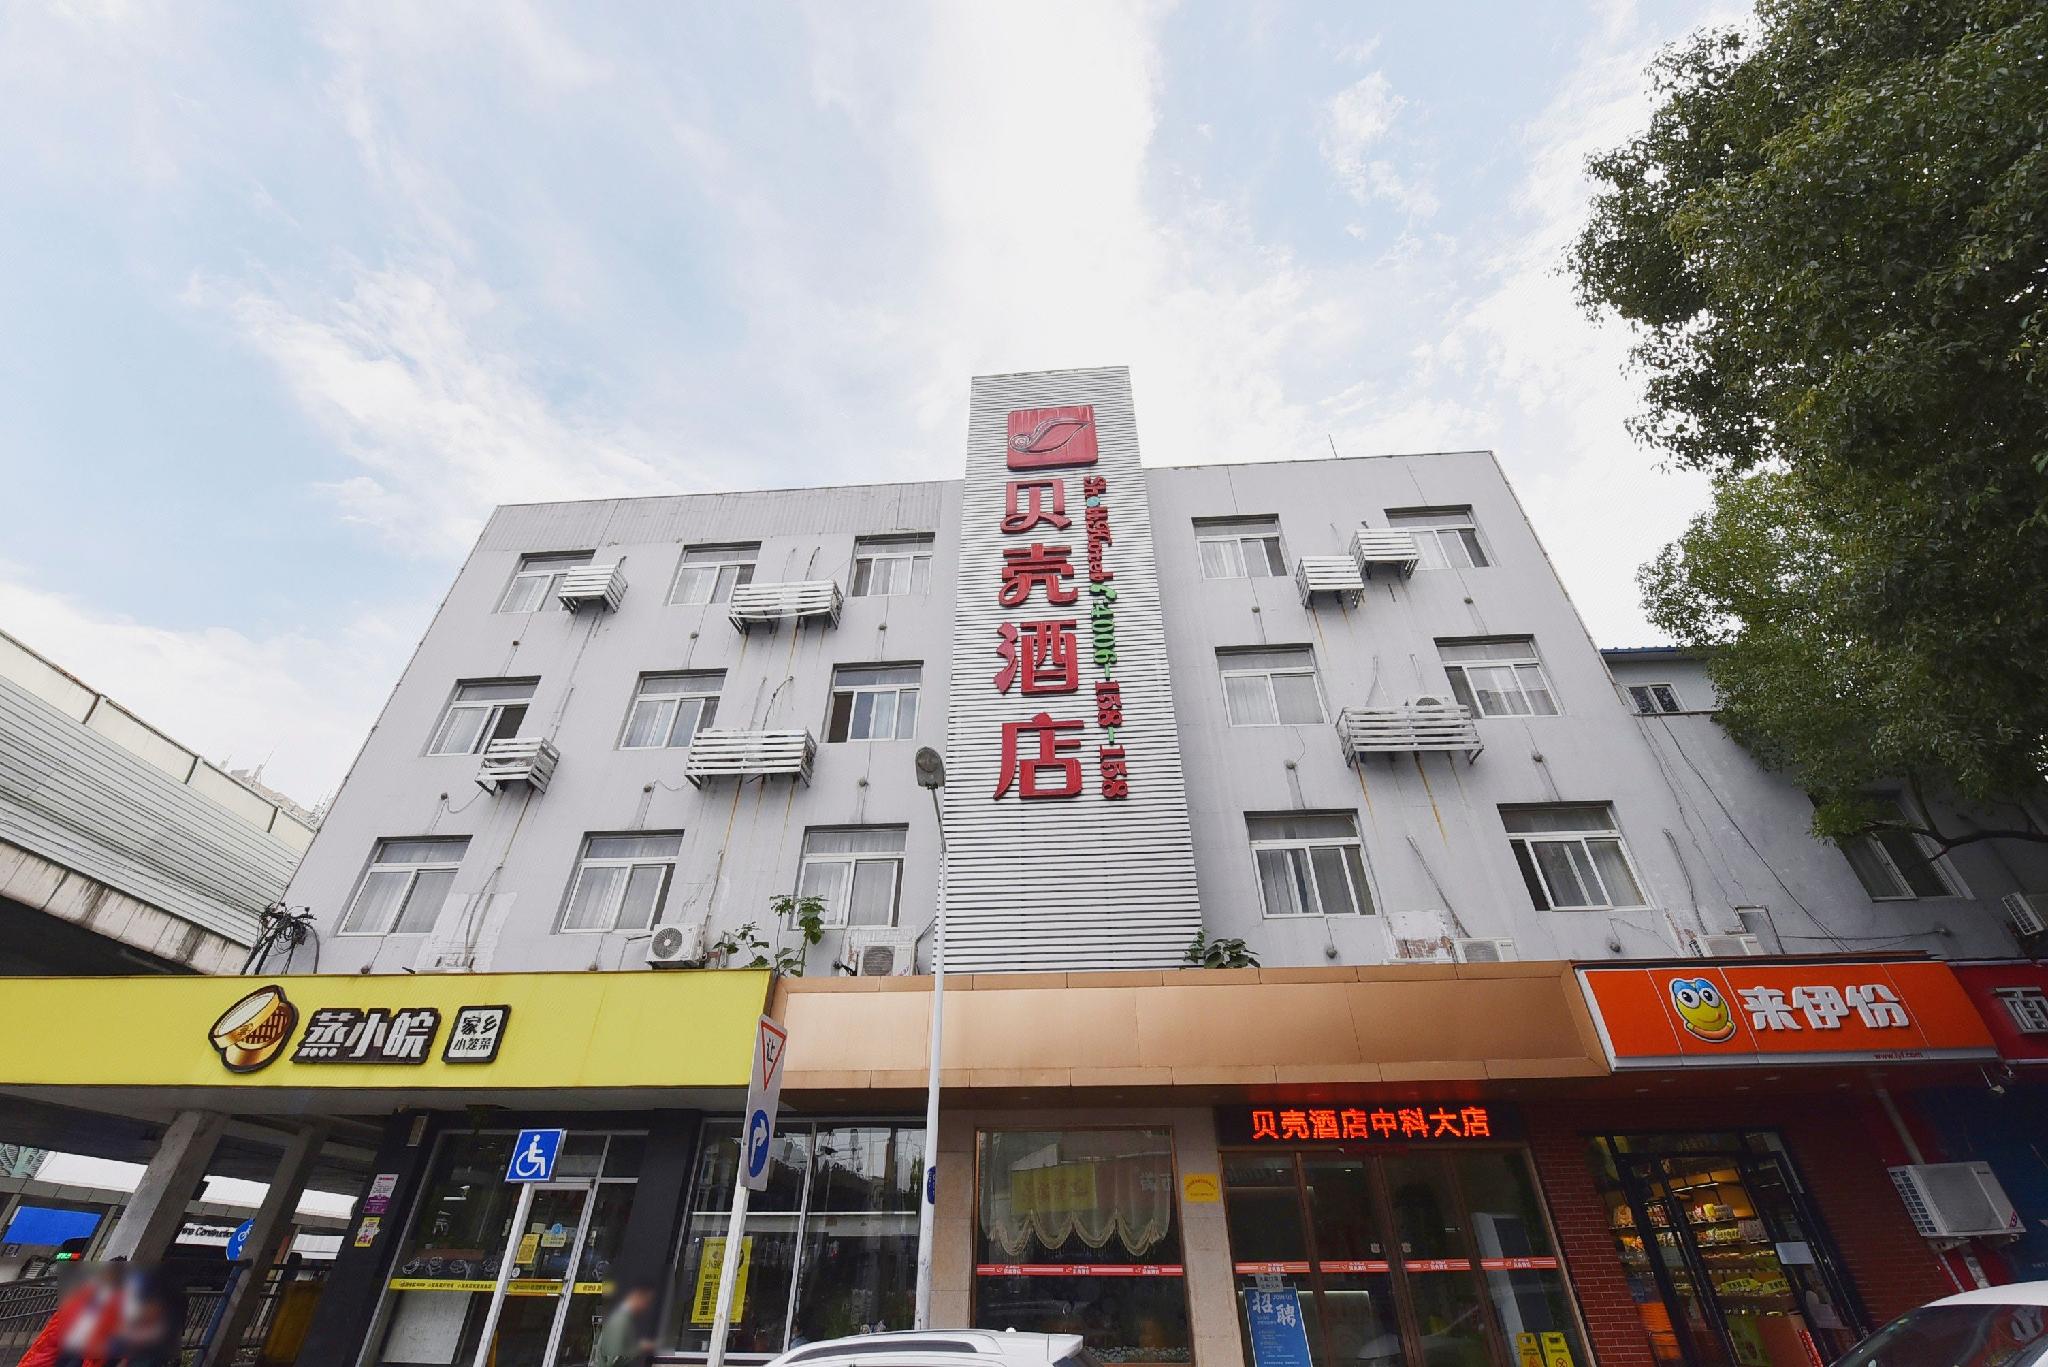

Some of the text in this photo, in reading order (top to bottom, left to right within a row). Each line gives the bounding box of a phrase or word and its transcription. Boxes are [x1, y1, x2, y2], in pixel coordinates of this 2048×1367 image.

[993, 479, 1085, 800] 贝壳酒店
[461, 1016, 497, 1035] 家乡
[1738, 985, 1910, 1030] 来伊份
[299, 1011, 436, 1058] 蒸小皖
[1252, 1107, 1491, 1139] 贝壳酒店中科大店
